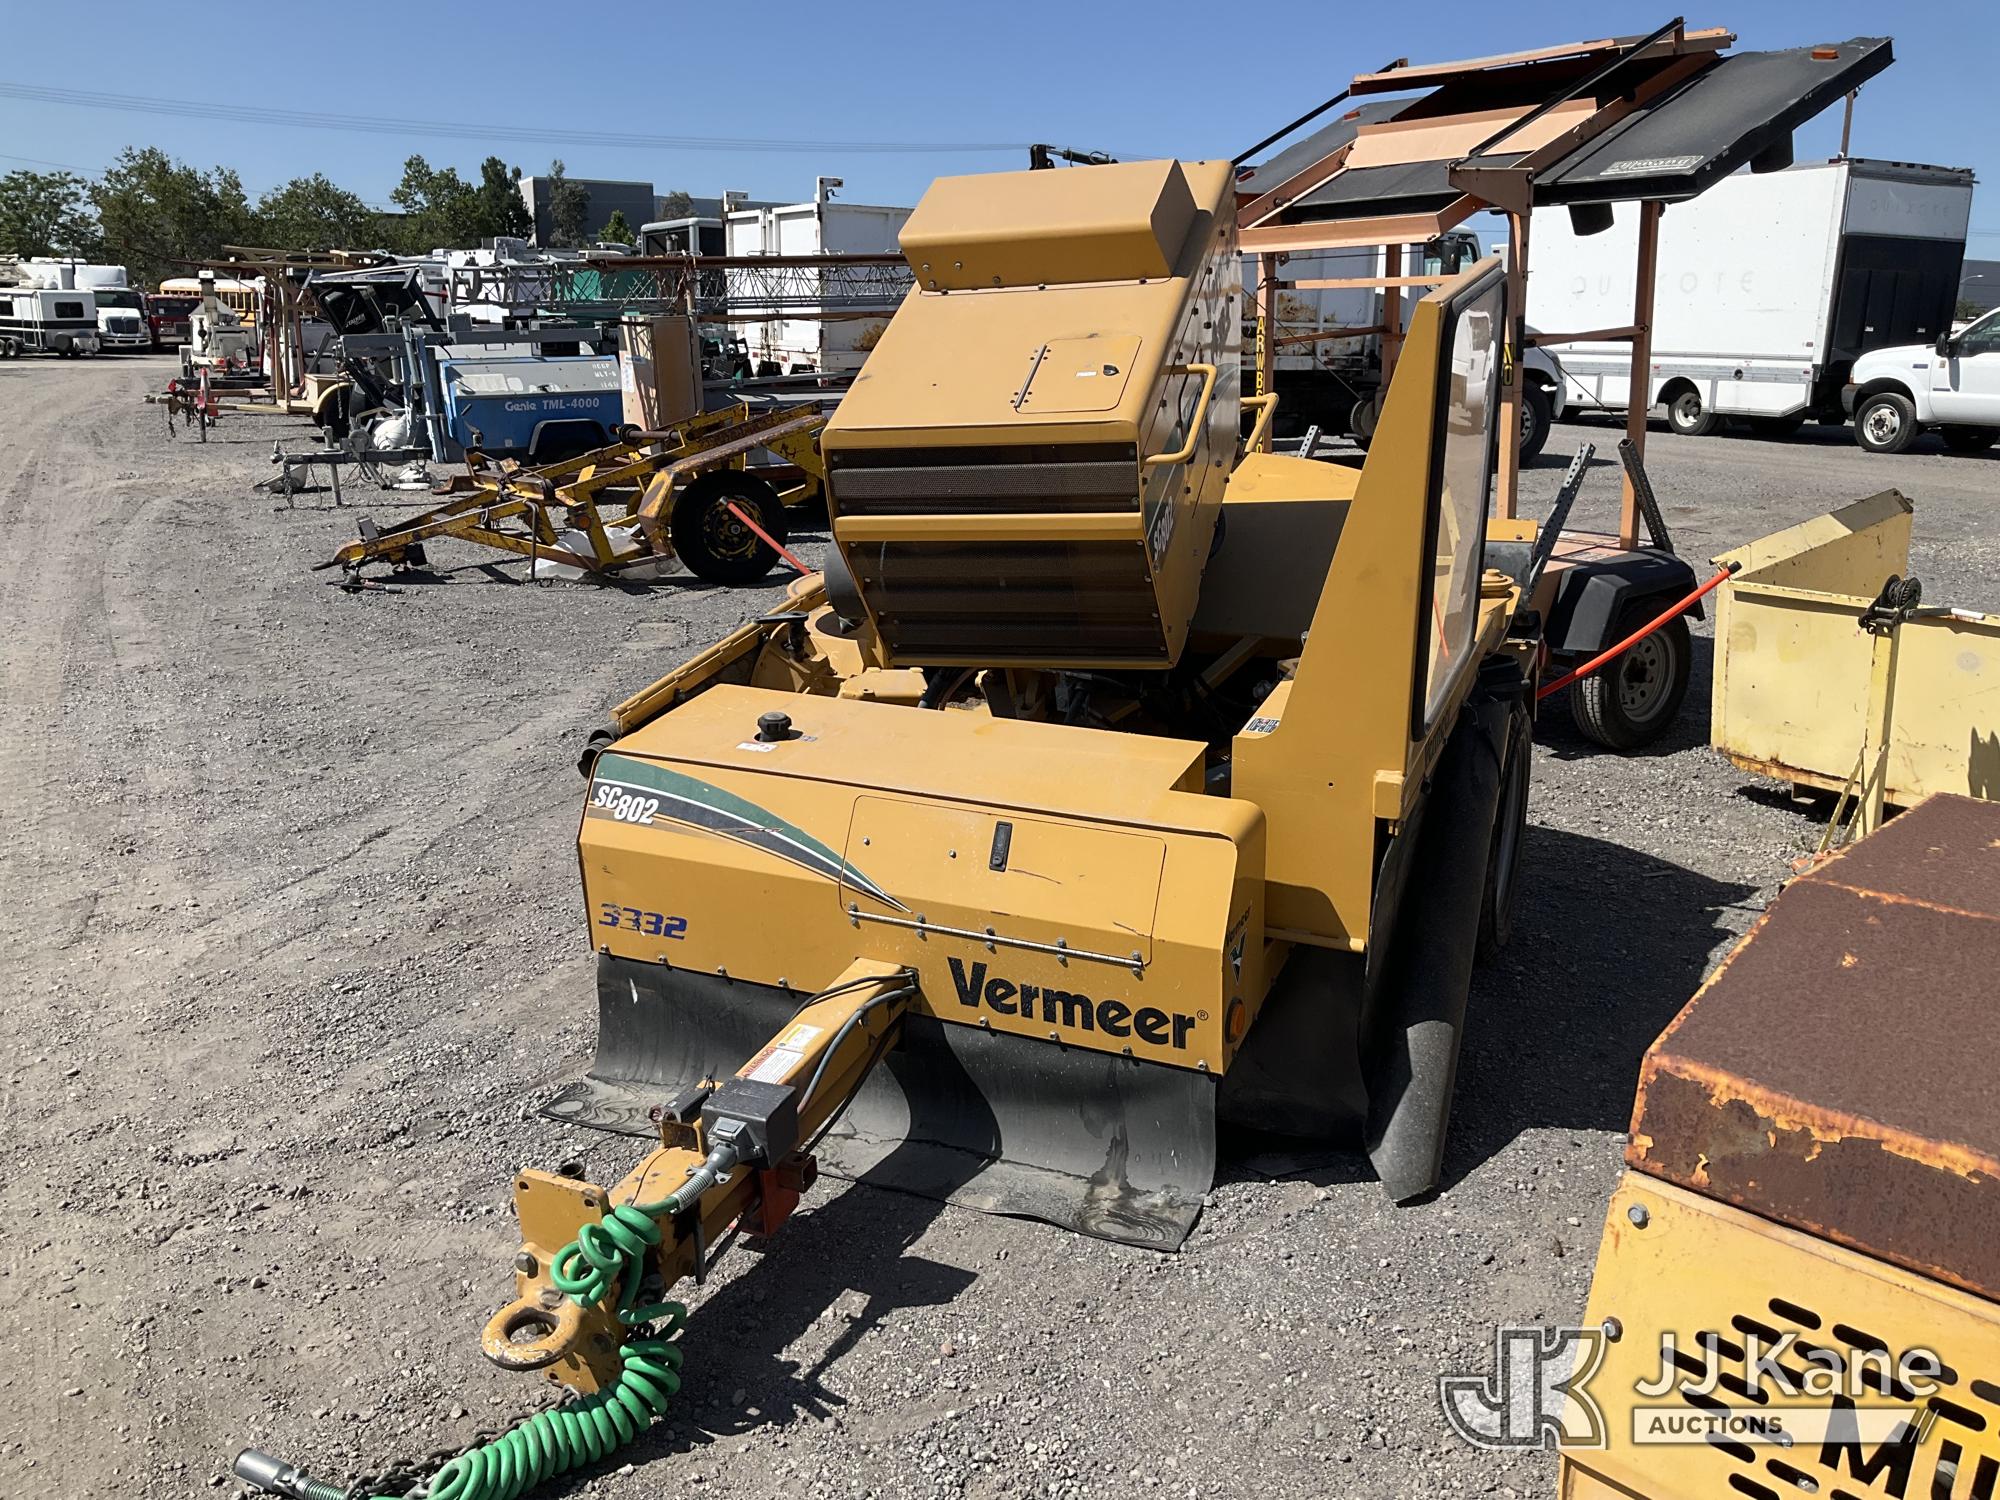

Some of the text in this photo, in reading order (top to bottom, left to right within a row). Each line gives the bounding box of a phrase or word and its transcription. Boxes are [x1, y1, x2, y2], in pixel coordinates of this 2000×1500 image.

[504, 397, 600, 412] Genie TML-4000
[594, 784, 659, 825] SC802
[598, 902, 688, 941] 3332
[947, 956, 1196, 1050] Vermeer
